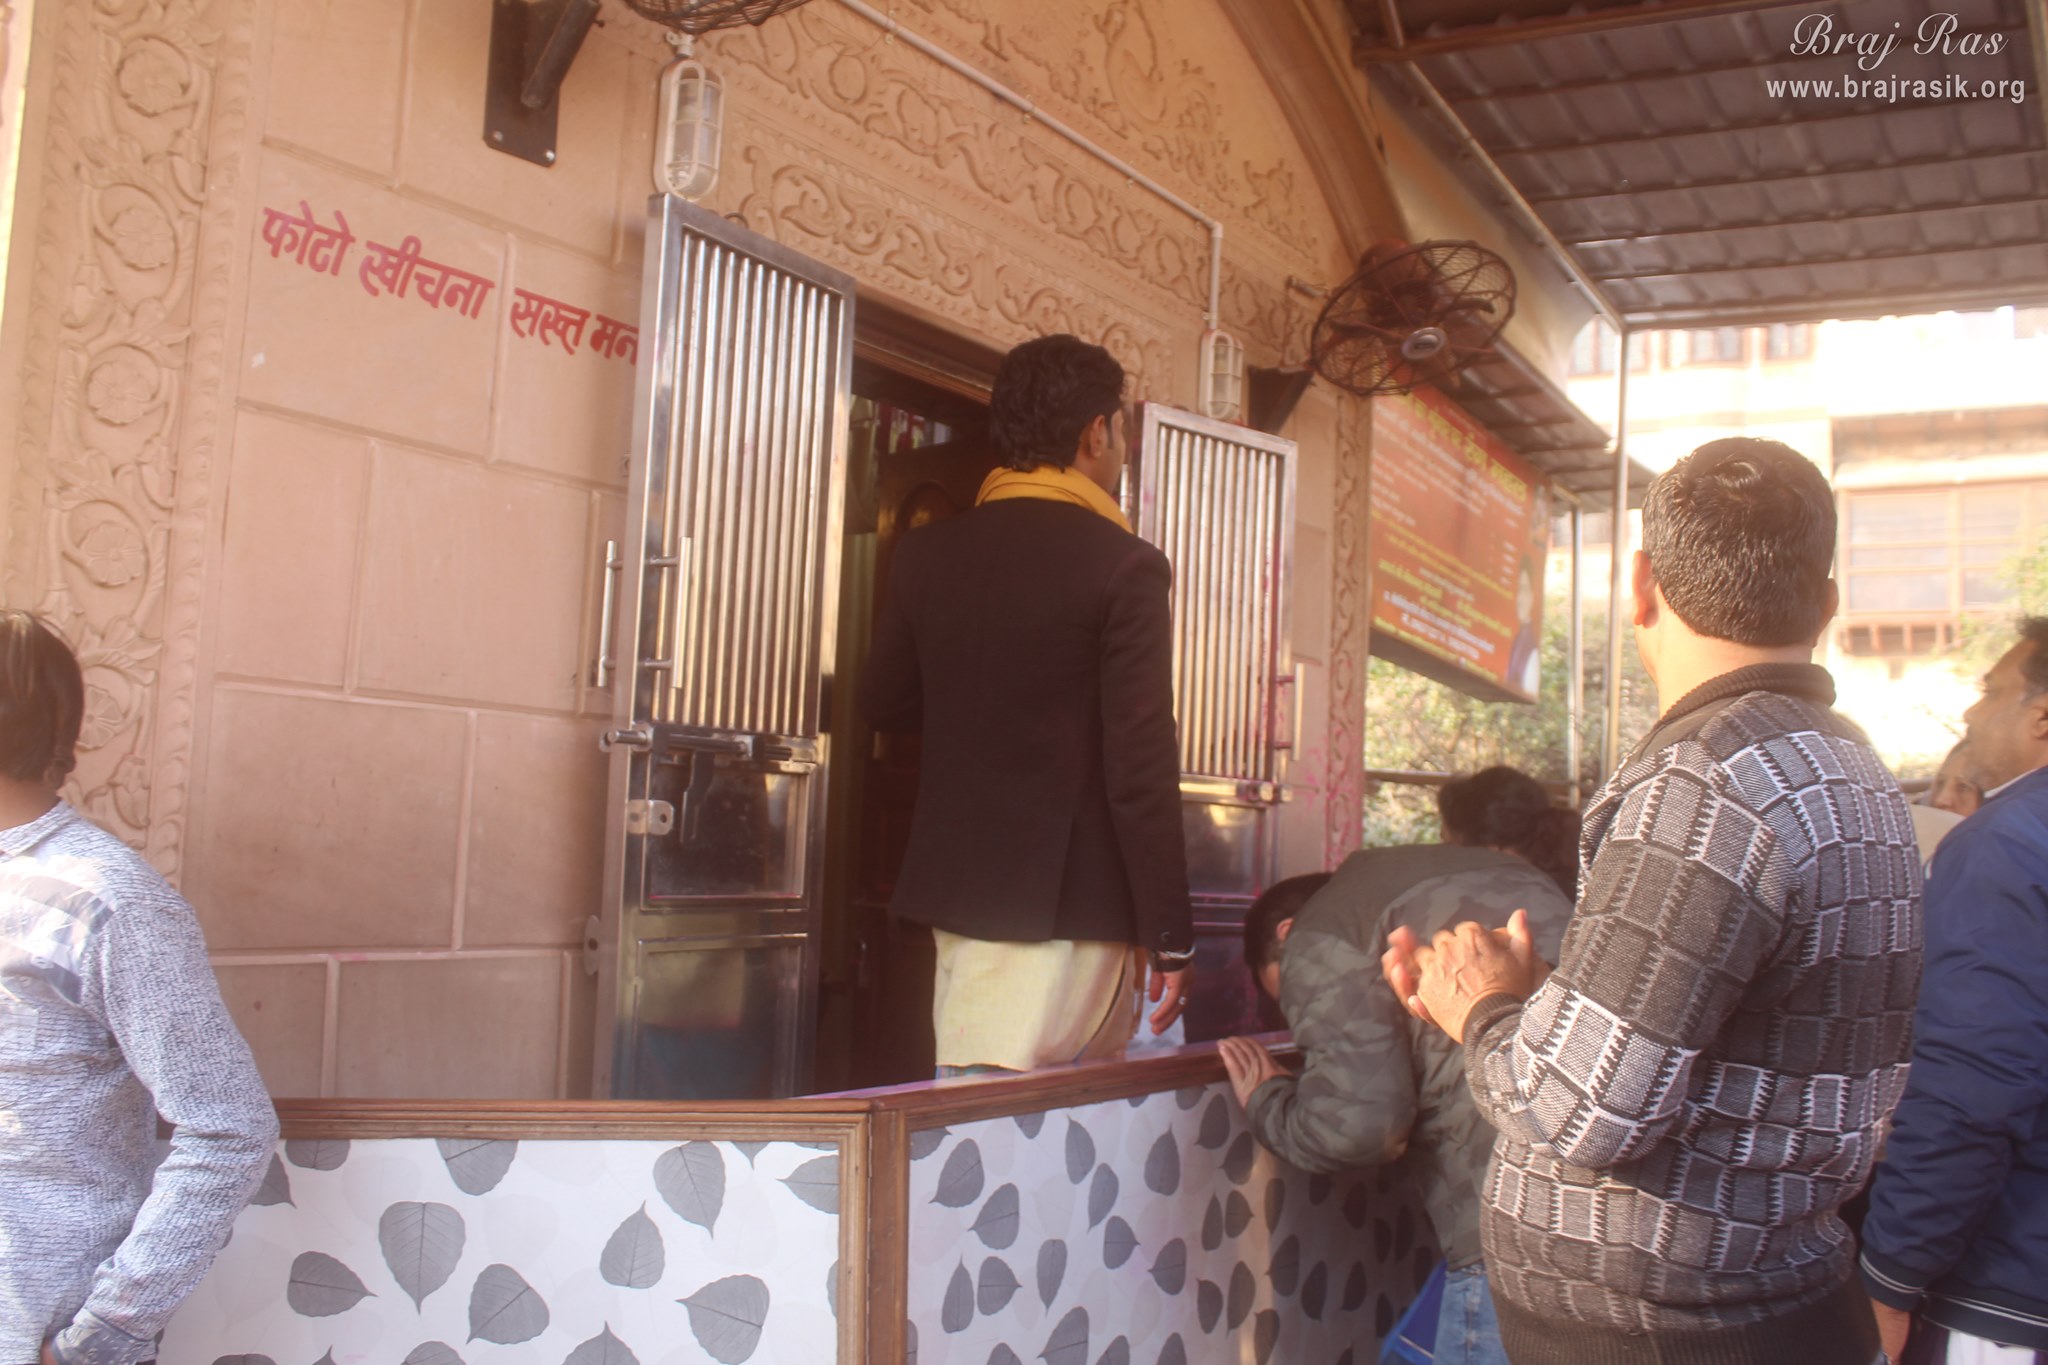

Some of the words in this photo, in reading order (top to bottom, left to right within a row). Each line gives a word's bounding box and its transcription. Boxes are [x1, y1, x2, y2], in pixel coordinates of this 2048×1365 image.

[263, 200, 356, 276] फोटो
[359, 235, 496, 320] खीचना
[510, 287, 591, 356] सख्त
[589, 313, 640, 366] मन
